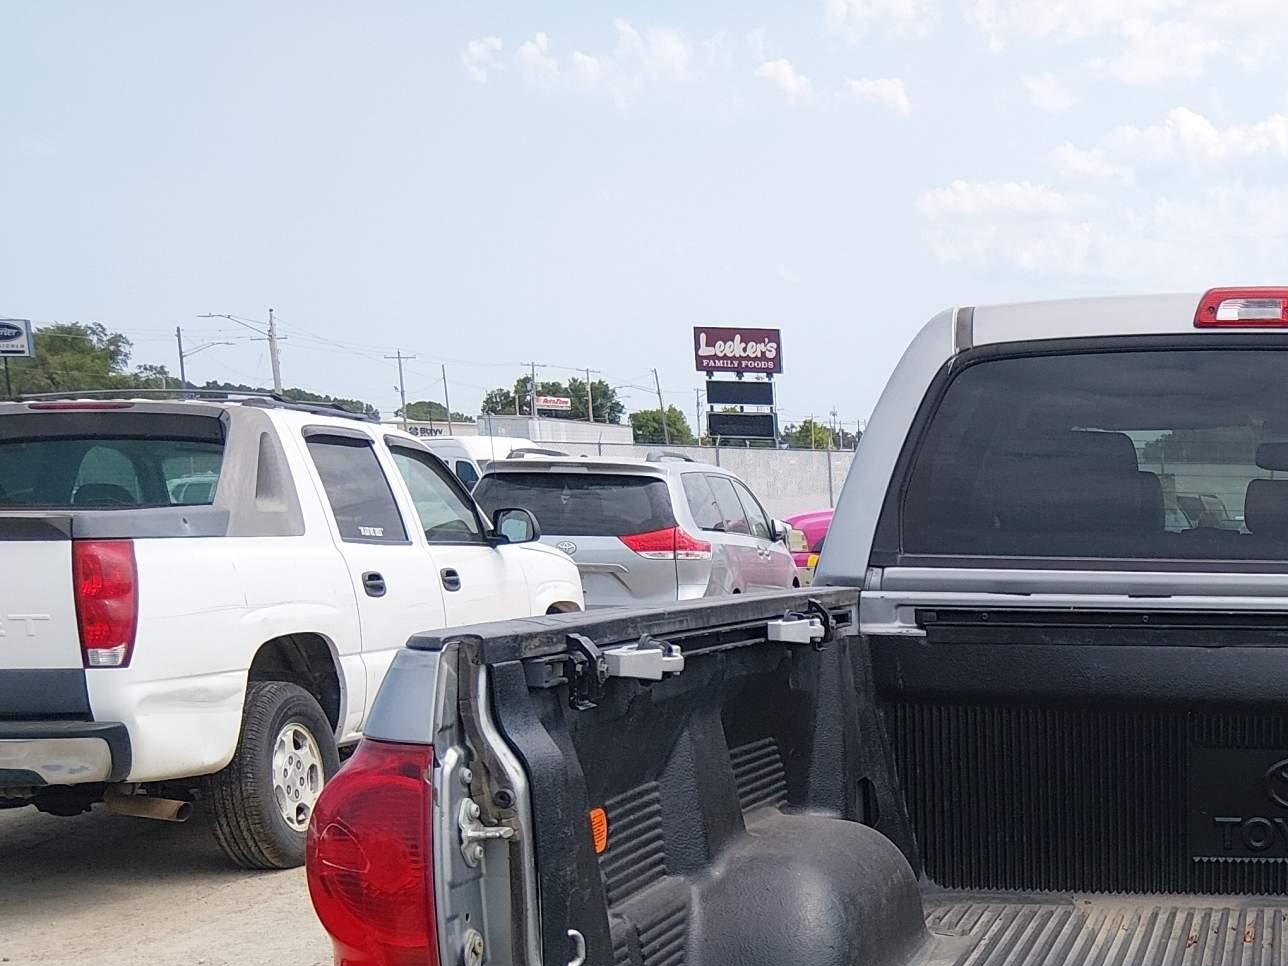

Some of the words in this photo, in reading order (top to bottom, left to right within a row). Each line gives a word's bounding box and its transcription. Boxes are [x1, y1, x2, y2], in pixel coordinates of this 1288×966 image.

[698, 332, 777, 358] Leeker's
[703, 360, 739, 368] FAMILY
[741, 361, 774, 369] FOODS
